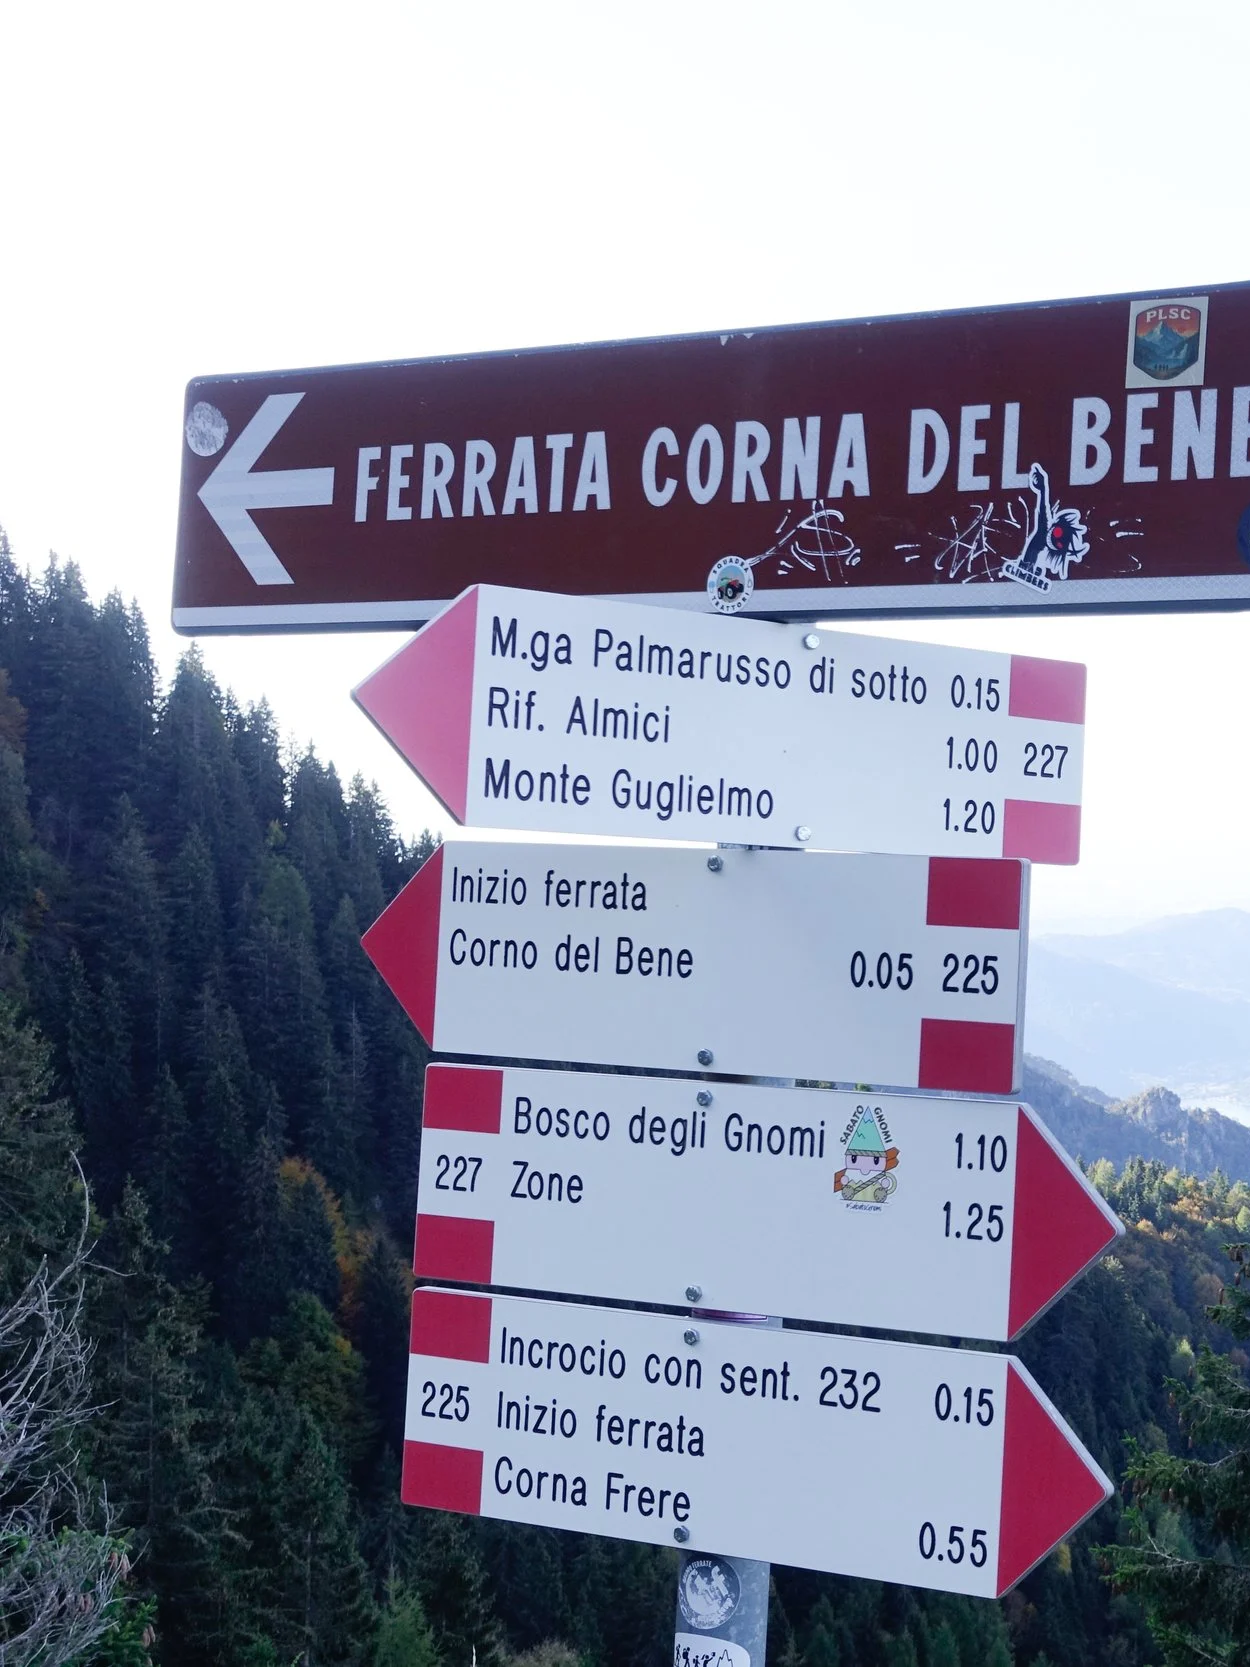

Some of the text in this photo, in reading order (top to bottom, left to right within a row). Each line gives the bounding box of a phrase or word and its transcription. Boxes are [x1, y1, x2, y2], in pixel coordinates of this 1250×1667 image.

[1146, 308, 1191, 323] PLSC
[354, 430, 611, 523] FERRATA
[641, 413, 870, 511] CORNA
[907, 402, 1031, 494] DEL
[712, 557, 749, 575] SQUADRA
[1005, 564, 1049, 591] CLIMBERS
[711, 592, 750, 611] TRATTORI
[491, 615, 1000, 712] M.ga Palmarusso di sotto 0.15
[487, 686, 998, 774] Rif. Almici 1.00
[1023, 742, 1069, 779] 227
[484, 757, 995, 835] Monte Guglielmo 1.20
[452, 866, 648, 912] Inizio ferrata
[449, 928, 914, 991] Corno del Bene 0.05
[942, 952, 999, 996] 225
[514, 1096, 1008, 1173] Bosco degli Gnomi 1.10
[840, 1104, 893, 1145] SABATO GNOMI
[435, 1154, 483, 1193] 227
[510, 1160, 1004, 1243] Zone 1.25
[500, 1326, 994, 1427] Incrocio con sent. 232 0.15
[421, 1380, 470, 1423] 225
[497, 1390, 705, 1457] Inizio ferrata
[494, 1455, 691, 1520] Corna Frere
[918, 1521, 988, 1568] 0.55
